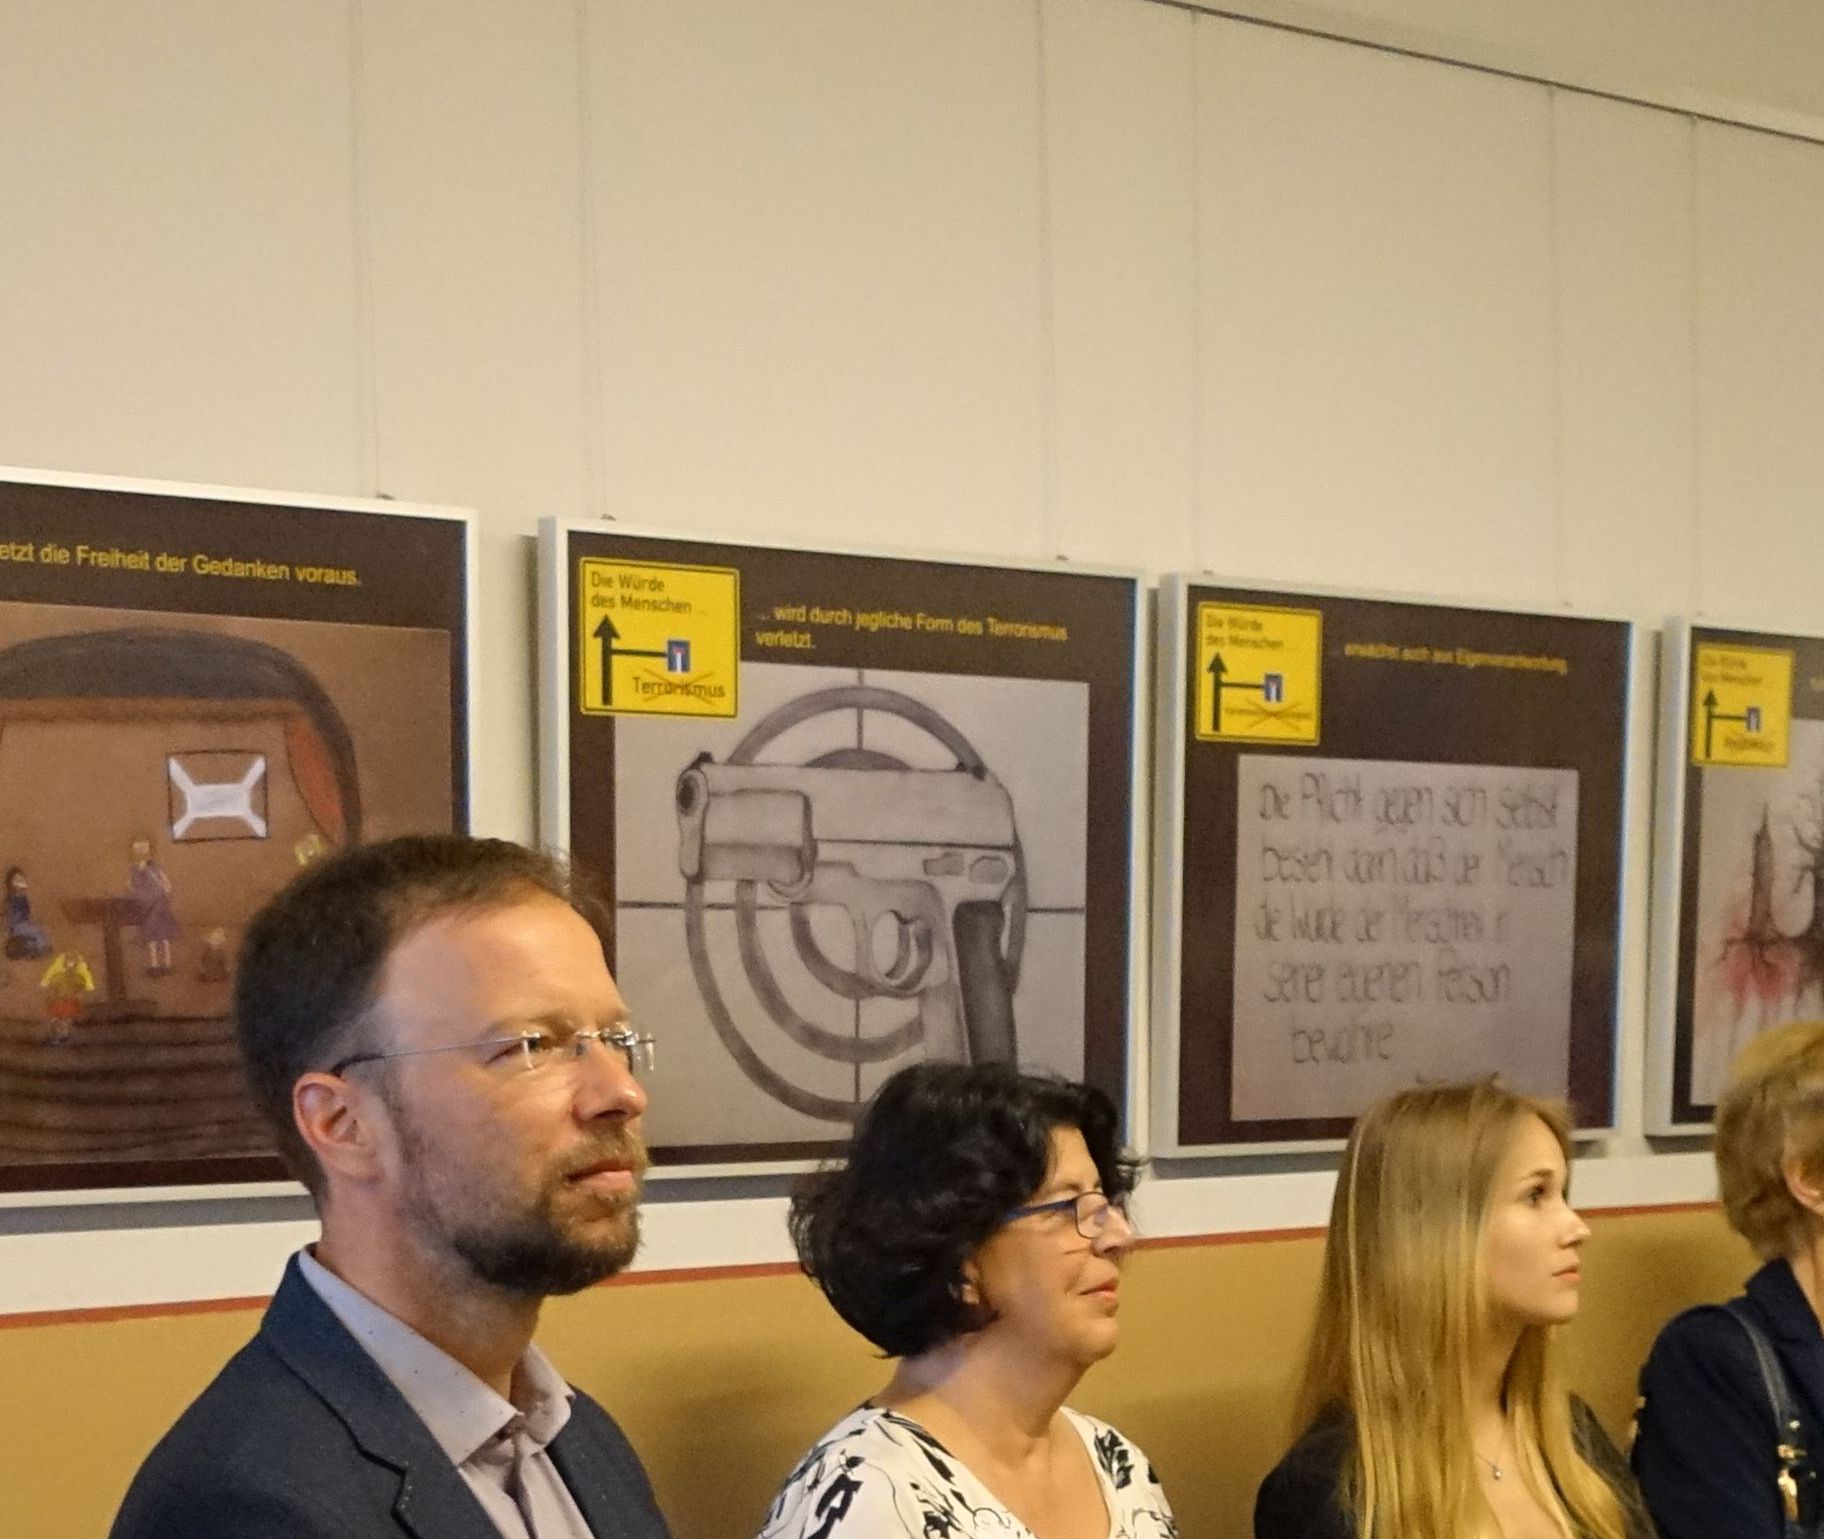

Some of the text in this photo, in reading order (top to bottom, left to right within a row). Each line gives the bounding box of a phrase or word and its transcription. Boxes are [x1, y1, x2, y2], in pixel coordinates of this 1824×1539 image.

[40, 545, 70, 565] die
[76, 545, 150, 571] Freiheit
[155, 552, 187, 574] der
[193, 555, 290, 581] Gedanken
[591, 572, 665, 591] Die Würde
[591, 594, 615, 608] des
[620, 595, 692, 614] Menschen
[775, 605, 806, 622] wird
[810, 607, 852, 625] durch
[916, 613, 954, 632] Form
[632, 676, 725, 698] Terrorismus
